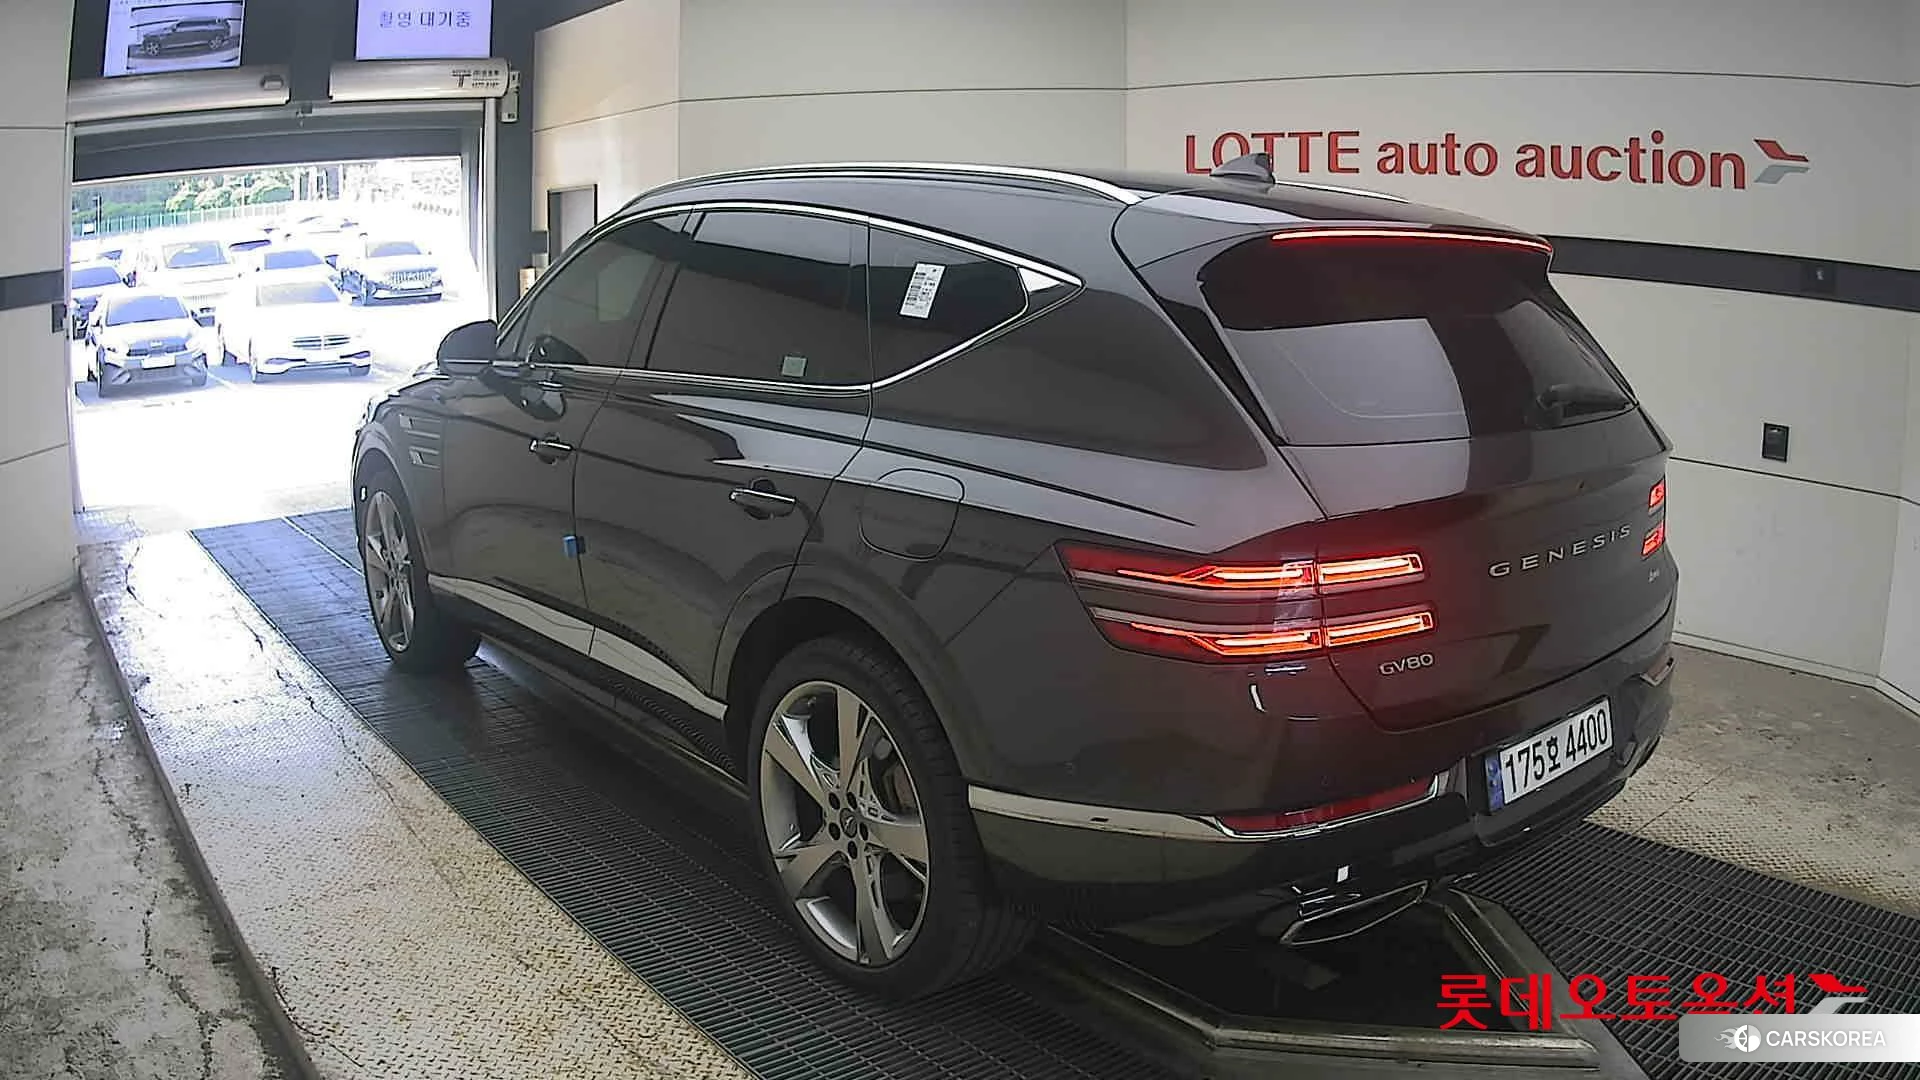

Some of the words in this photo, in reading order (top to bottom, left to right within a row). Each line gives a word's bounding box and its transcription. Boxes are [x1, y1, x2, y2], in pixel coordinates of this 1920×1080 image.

[420, 10, 472, 28] 대기중
[1185, 131, 1360, 175] LOTTE
[1376, 133, 1499, 178] auto
[1516, 130, 1746, 189] auction
[1488, 523, 1631, 578] GENESIS
[1378, 652, 1434, 676] GV80
[1505, 736, 1561, 793] 175호
[1566, 709, 1608, 762] 4400
